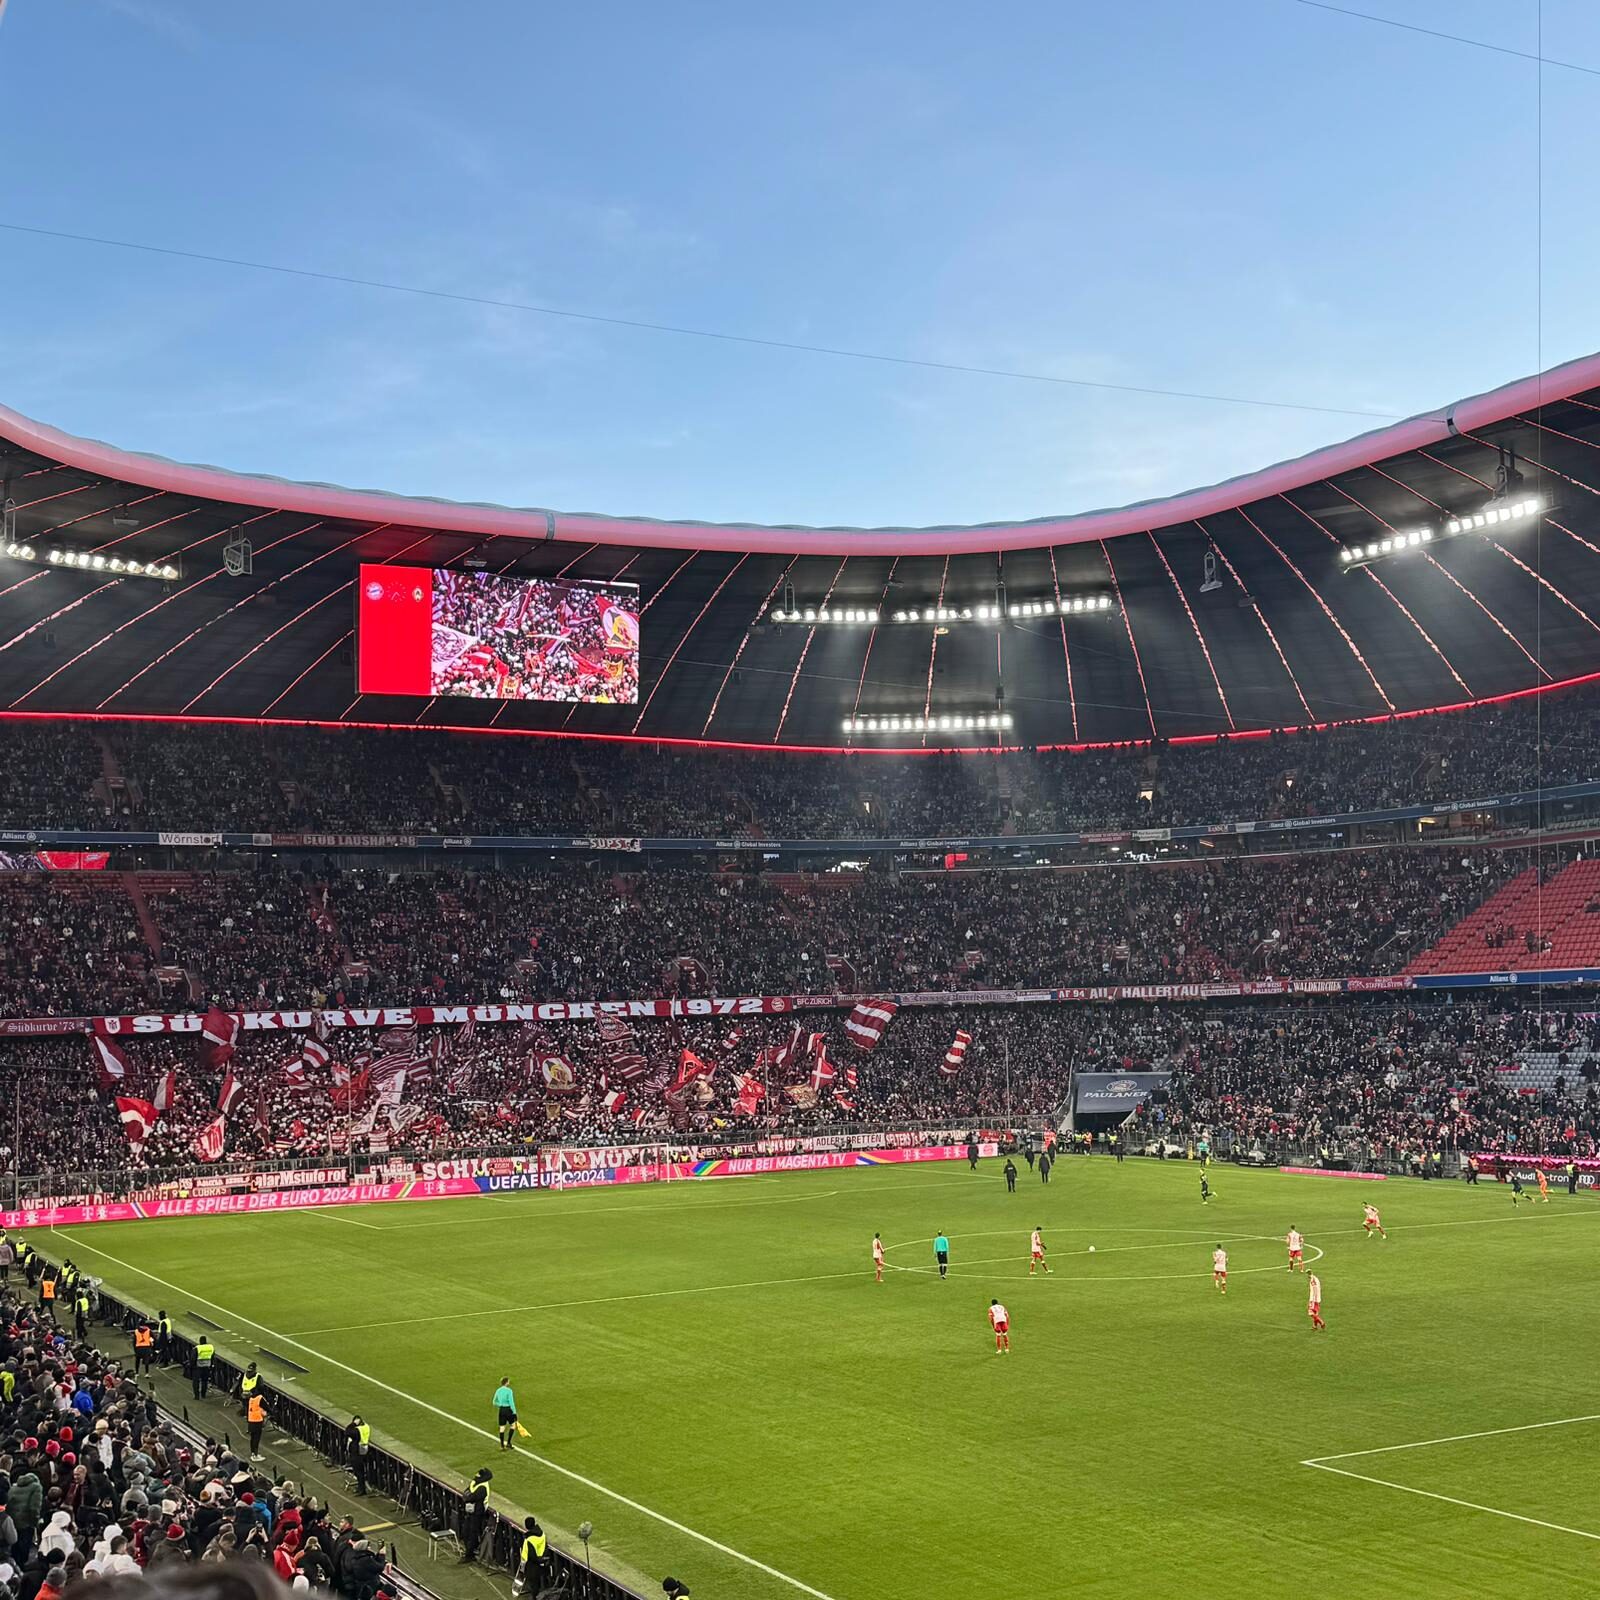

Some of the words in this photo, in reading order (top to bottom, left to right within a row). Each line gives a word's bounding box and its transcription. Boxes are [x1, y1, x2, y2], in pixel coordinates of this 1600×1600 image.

[1311, 817, 1335, 825] Investors
[1489, 974, 1508, 983] Allianz
[1122, 984, 1199, 998] HALLERTAU
[132, 1007, 413, 1033] SÜKURVE
[432, 1000, 656, 1024] MÜNCHEN
[672, 998, 763, 1016] 1972
[7, 1021, 58, 1033] Südkurve
[1084, 1091, 1148, 1099] PAULANER
[728, 1159, 753, 1173] NUR
[755, 1157, 774, 1171] BEI
[776, 1154, 829, 1169] MAGENTA
[831, 1153, 846, 1165] TV
[327, 1169, 347, 1183] rot
[1516, 1171, 1535, 1181] Audi
[1546, 1172, 1569, 1183] -tron
[155, 1200, 192, 1215] ALLE
[195, 1195, 246, 1212] SPIELE
[248, 1194, 279, 1208] DER
[281, 1189, 320, 1205] EURO
[322, 1187, 357, 1202] 2024
[359, 1184, 390, 1199] LIVE
